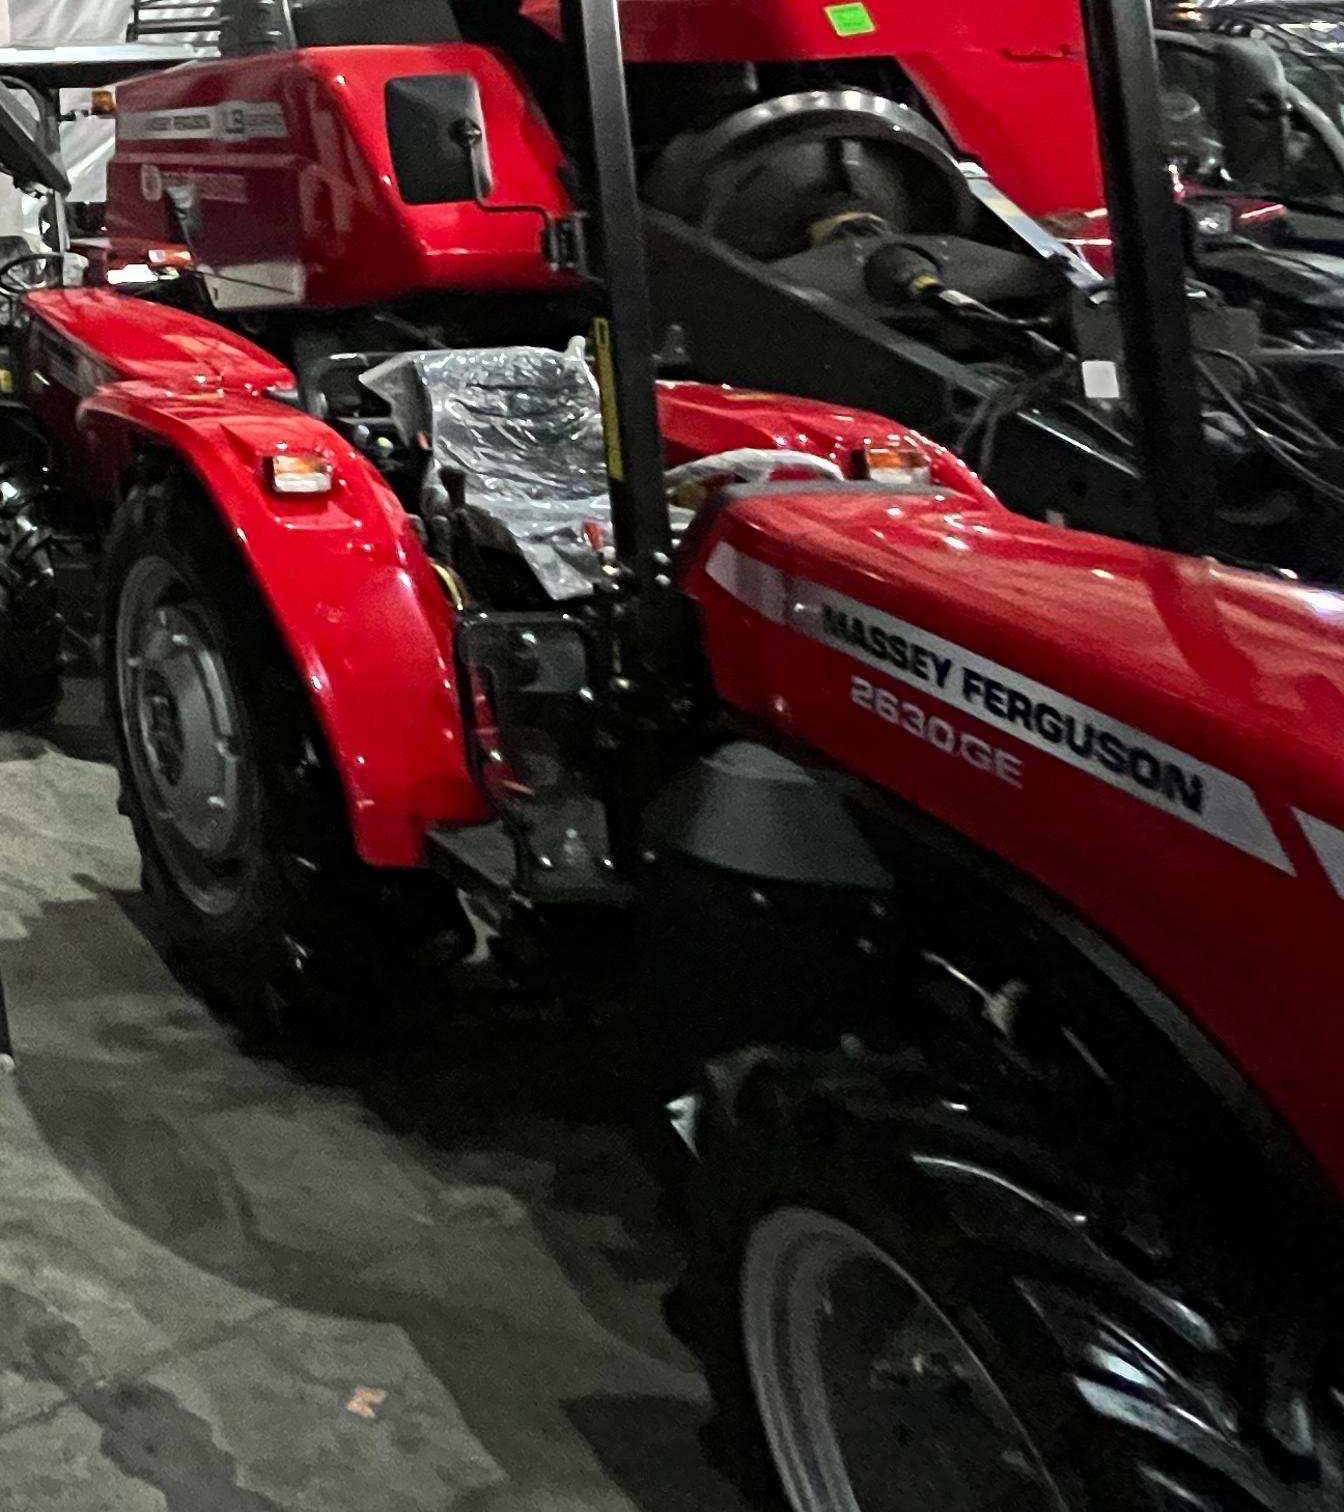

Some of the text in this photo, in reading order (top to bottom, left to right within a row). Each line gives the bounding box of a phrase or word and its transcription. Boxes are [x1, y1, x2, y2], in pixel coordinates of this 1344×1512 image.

[820, 603, 1205, 816] MASSEY FERGUSON
[850, 674, 1024, 790] 2630GE
